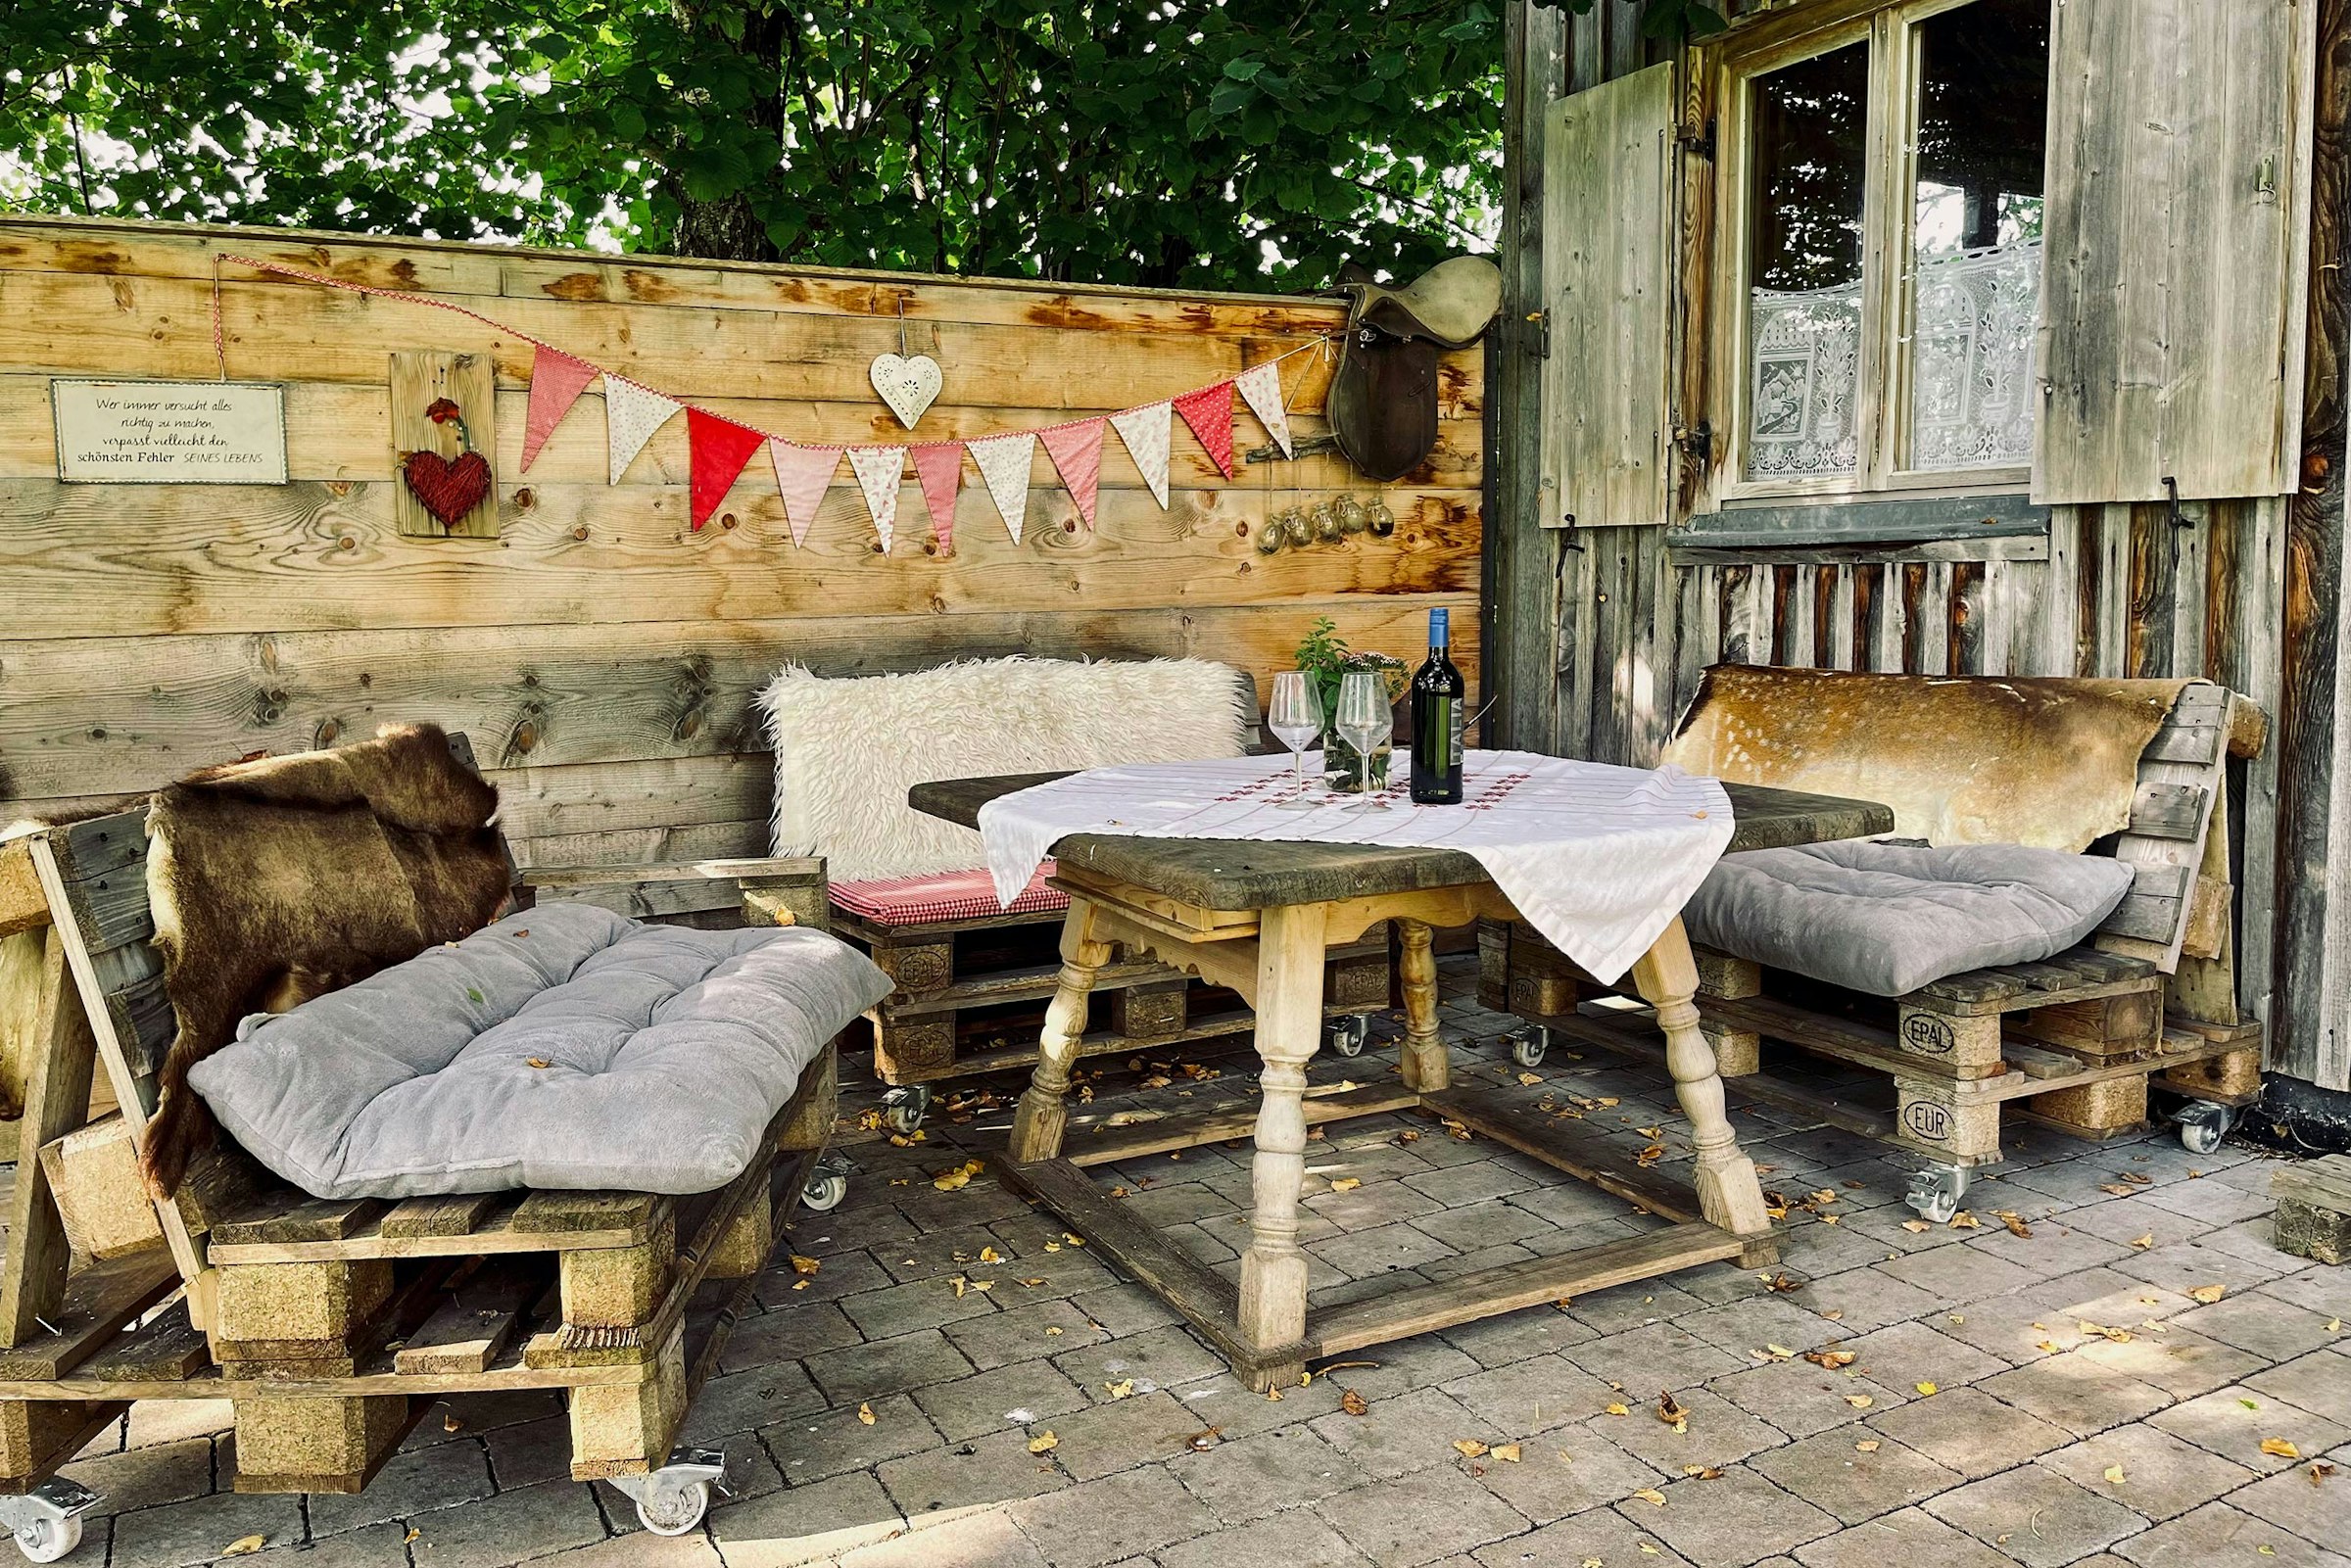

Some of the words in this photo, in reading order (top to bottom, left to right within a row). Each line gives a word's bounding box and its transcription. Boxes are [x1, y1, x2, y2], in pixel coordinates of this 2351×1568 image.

[96, 397, 120, 409] Wer
[123, 400, 161, 410] immer
[165, 400, 207, 410] versucht
[212, 399, 232, 411] alles
[121, 416, 154, 433] richtig
[175, 418, 215, 429] machen,
[103, 434, 151, 451] verpasst
[154, 434, 206, 446] vielleicht
[209, 434, 229, 447] den
[77, 451, 133, 462] schönsten
[137, 452, 175, 463] Fehler
[184, 452, 220, 463] SEINES
[223, 452, 264, 463] LEBENS
[1910, 1020, 1948, 1049] EPAL
[1914, 1107, 1944, 1137] EUR
